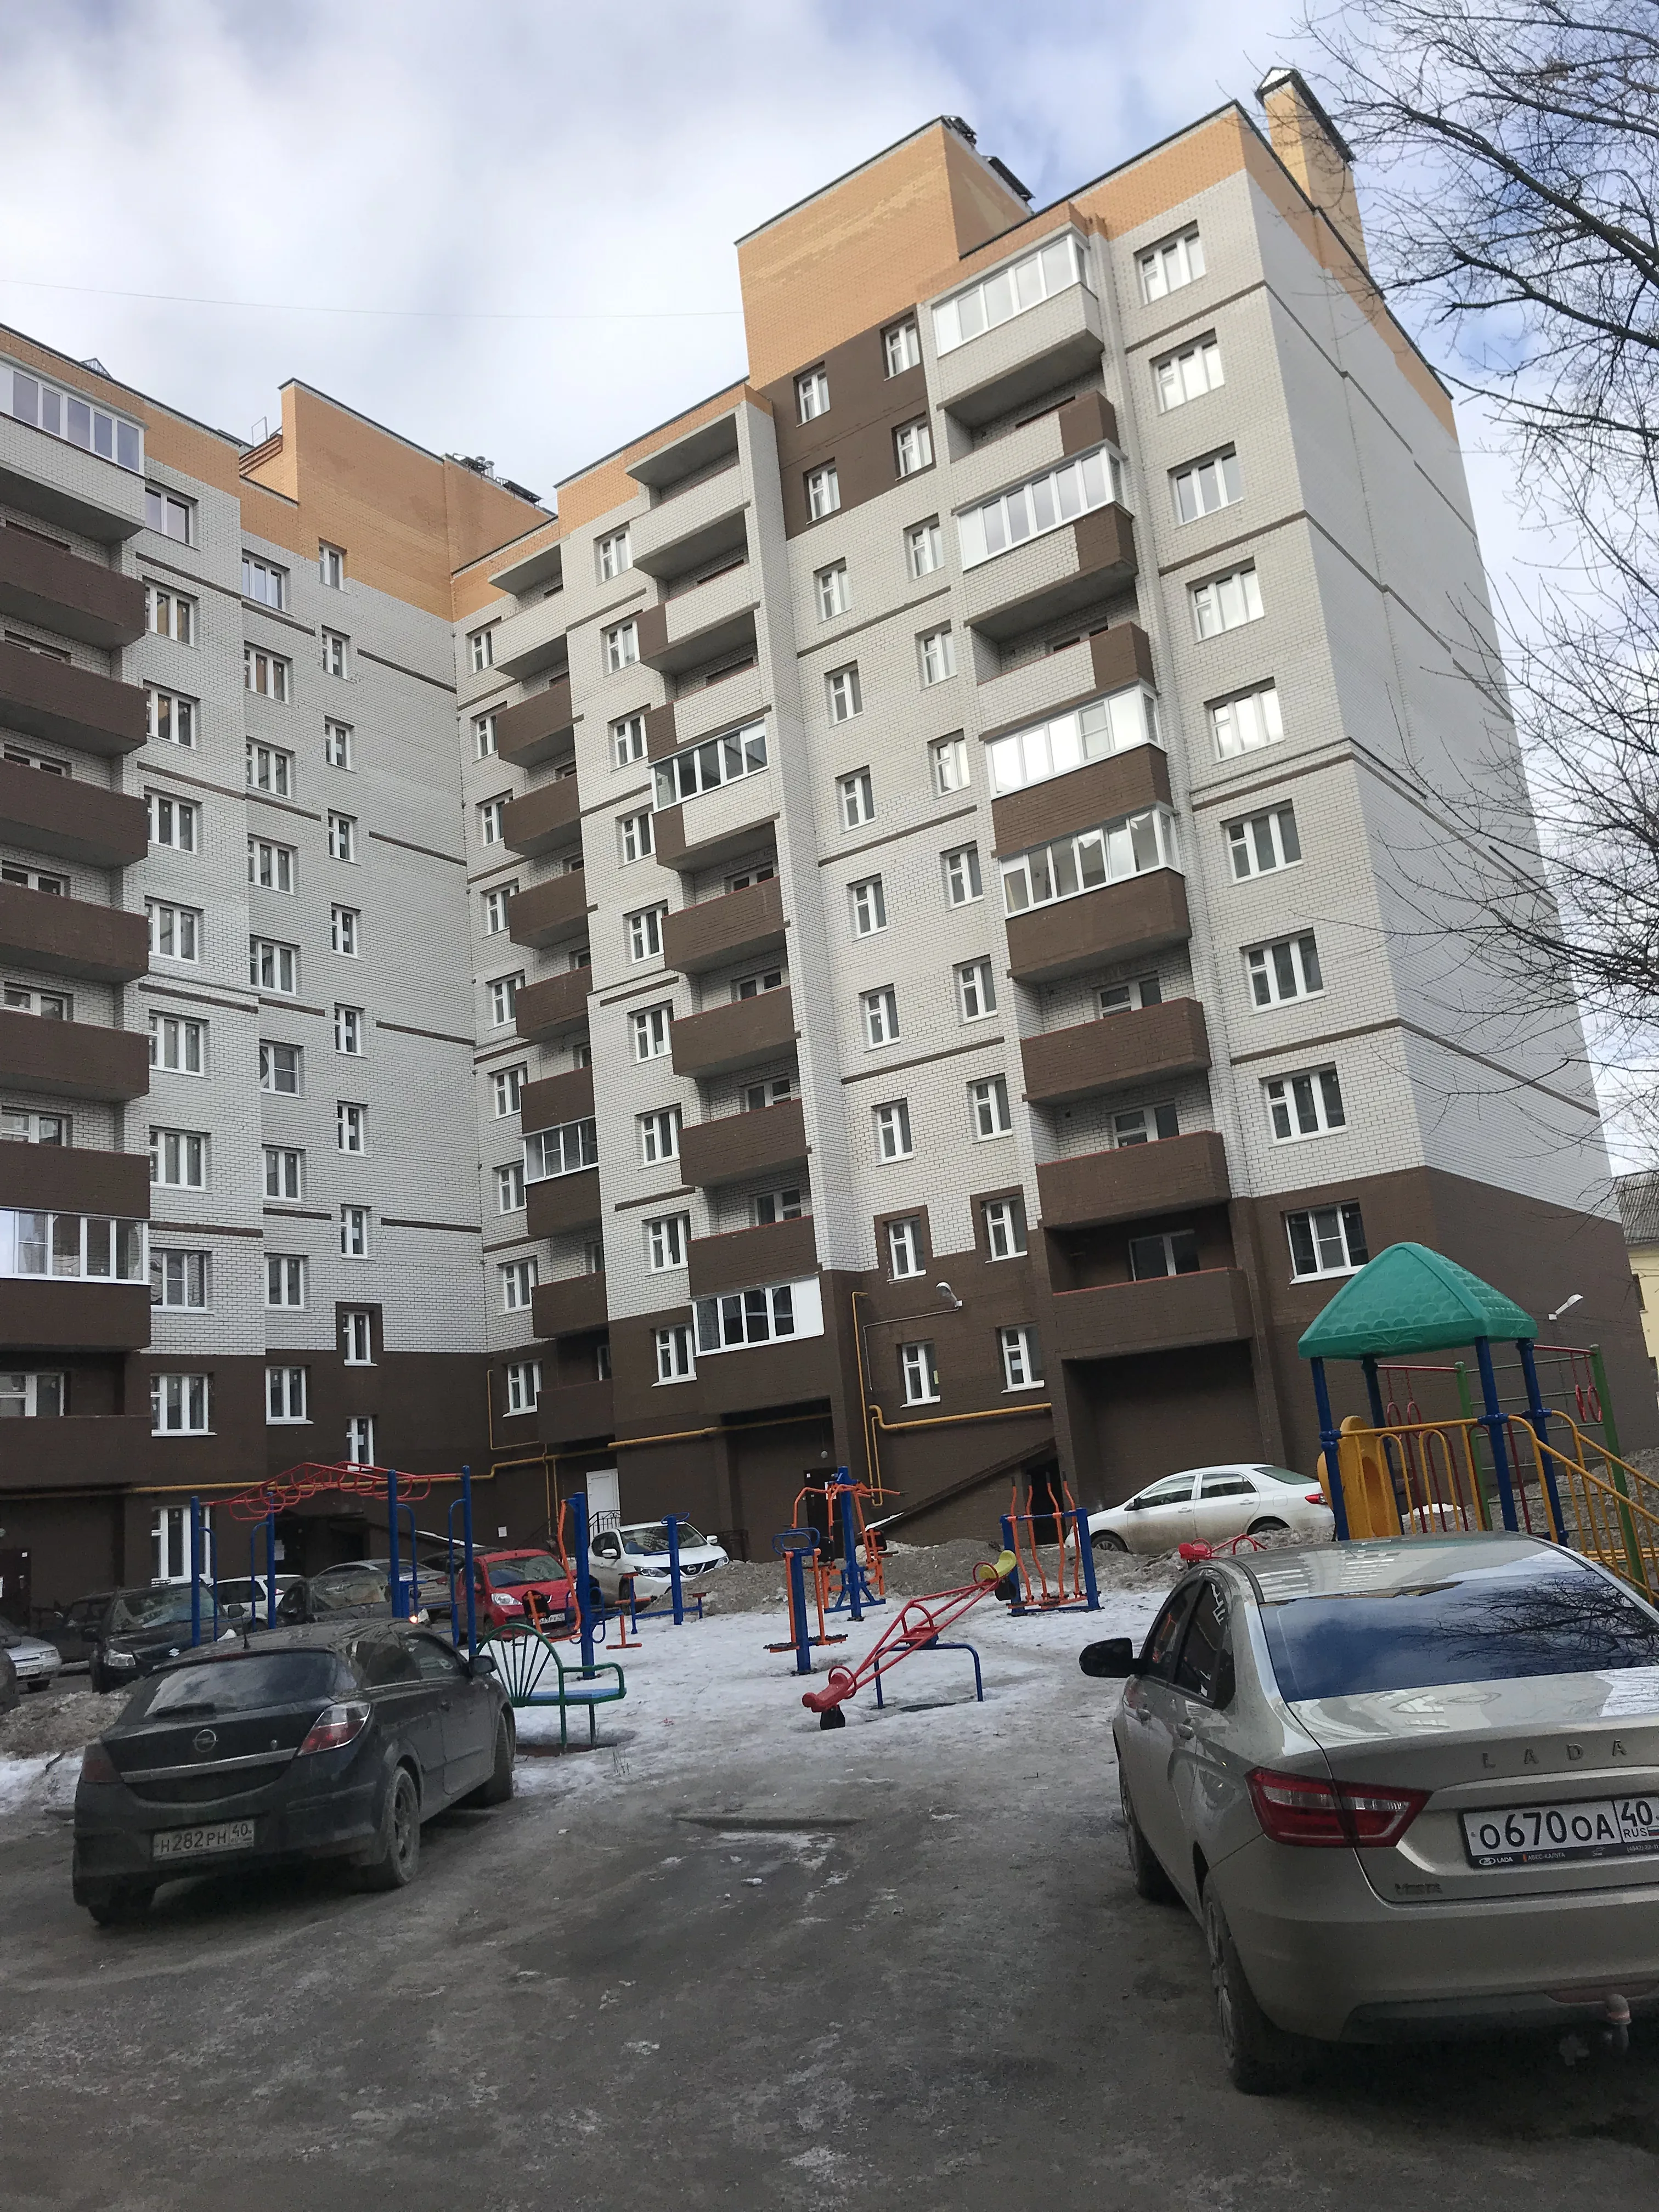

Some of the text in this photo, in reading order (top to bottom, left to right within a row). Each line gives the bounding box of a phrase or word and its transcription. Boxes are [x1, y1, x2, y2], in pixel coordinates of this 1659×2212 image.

[1482, 1739, 1627, 1768] LADA
[232, 1823, 249, 1837] 40
[1480, 1801, 1653, 1849] О670ОА 40
[1623, 1827, 1647, 1838] RUS
